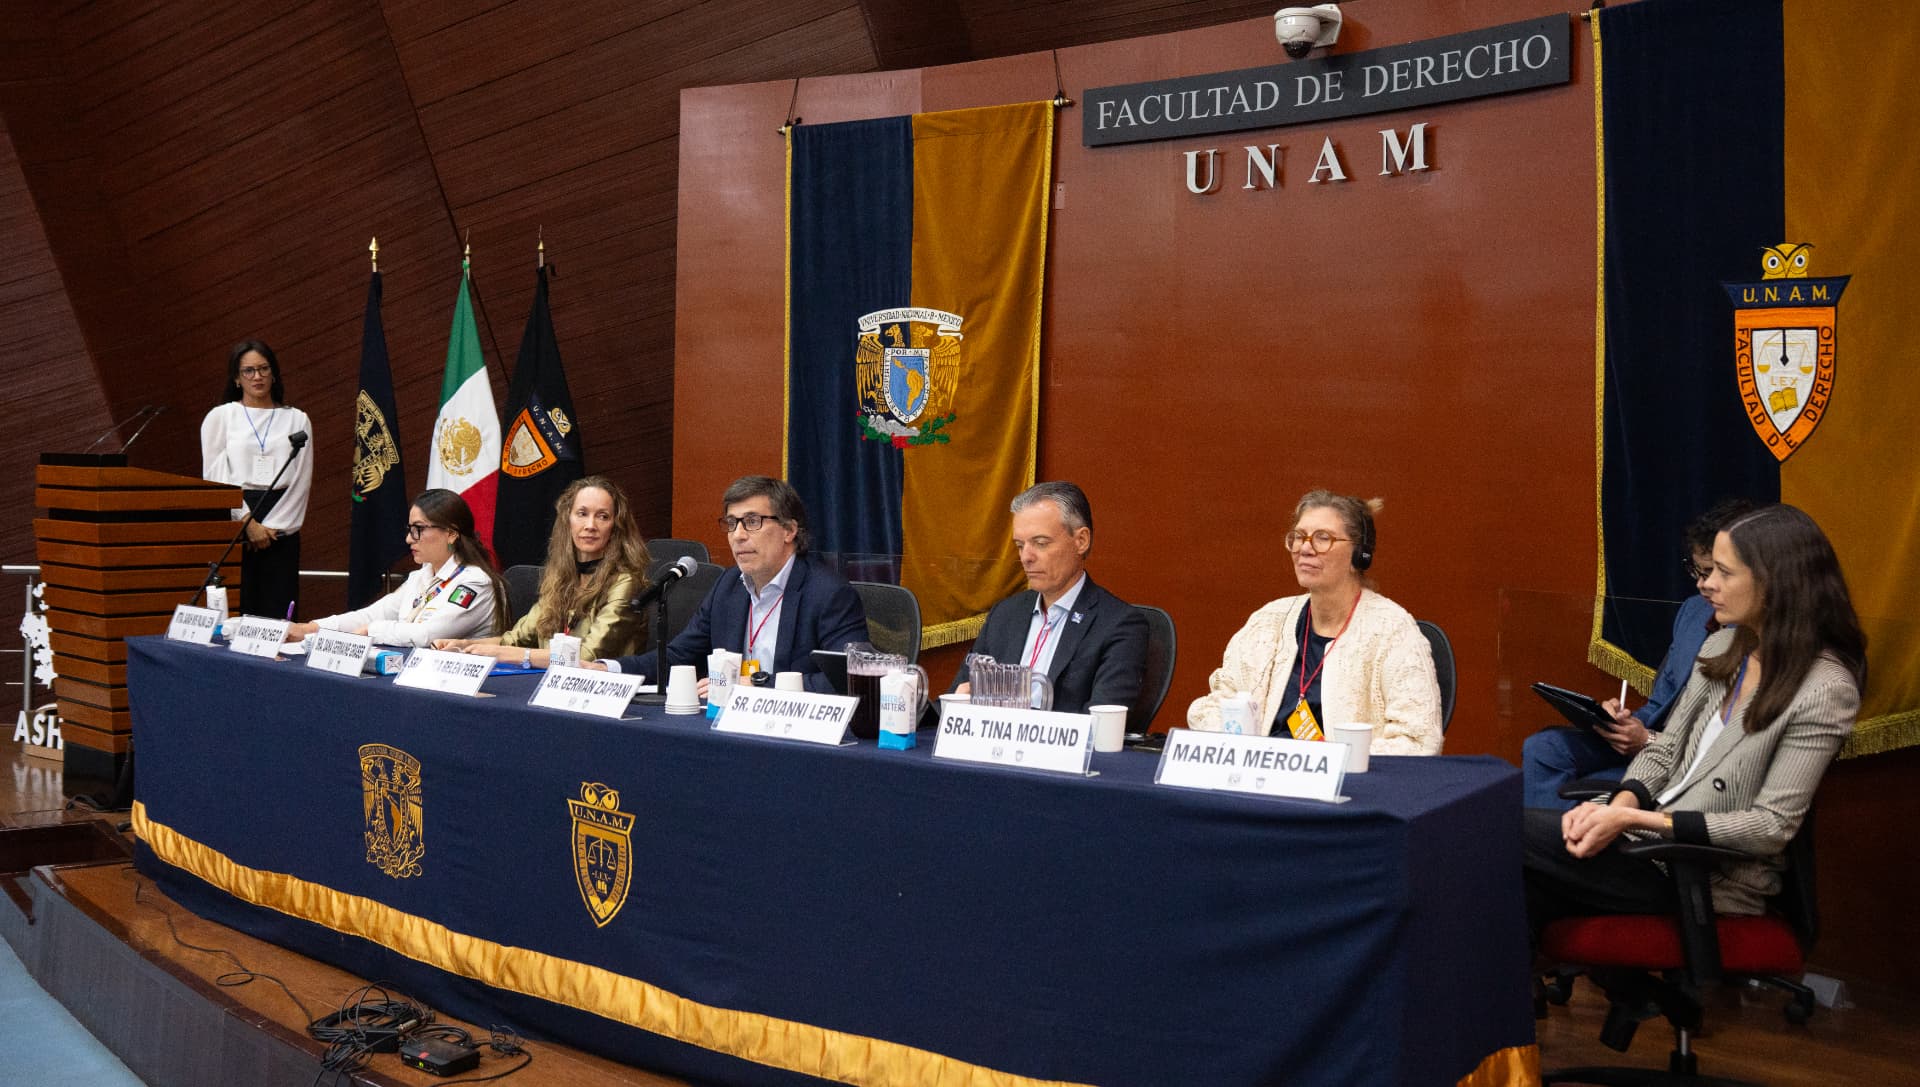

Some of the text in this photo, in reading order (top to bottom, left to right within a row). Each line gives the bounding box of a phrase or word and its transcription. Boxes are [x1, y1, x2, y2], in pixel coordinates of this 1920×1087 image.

[1096, 34, 1551, 130] FACULTAD DE DERECHO
[1737, 326, 1833, 450] FACULTAD DE DERECHO
[1770, 376, 1798, 387] LEX
[546, 675, 633, 699] SR. GERMAN ZAPPANI
[731, 695, 845, 723] SR. GIOVANNI LEPRI
[944, 716, 1079, 747] SRA. TINA MOLUND
[1172, 742, 1329, 774] MARÍA MÉROLA
[574, 805, 627, 830] U.N.A.M.
